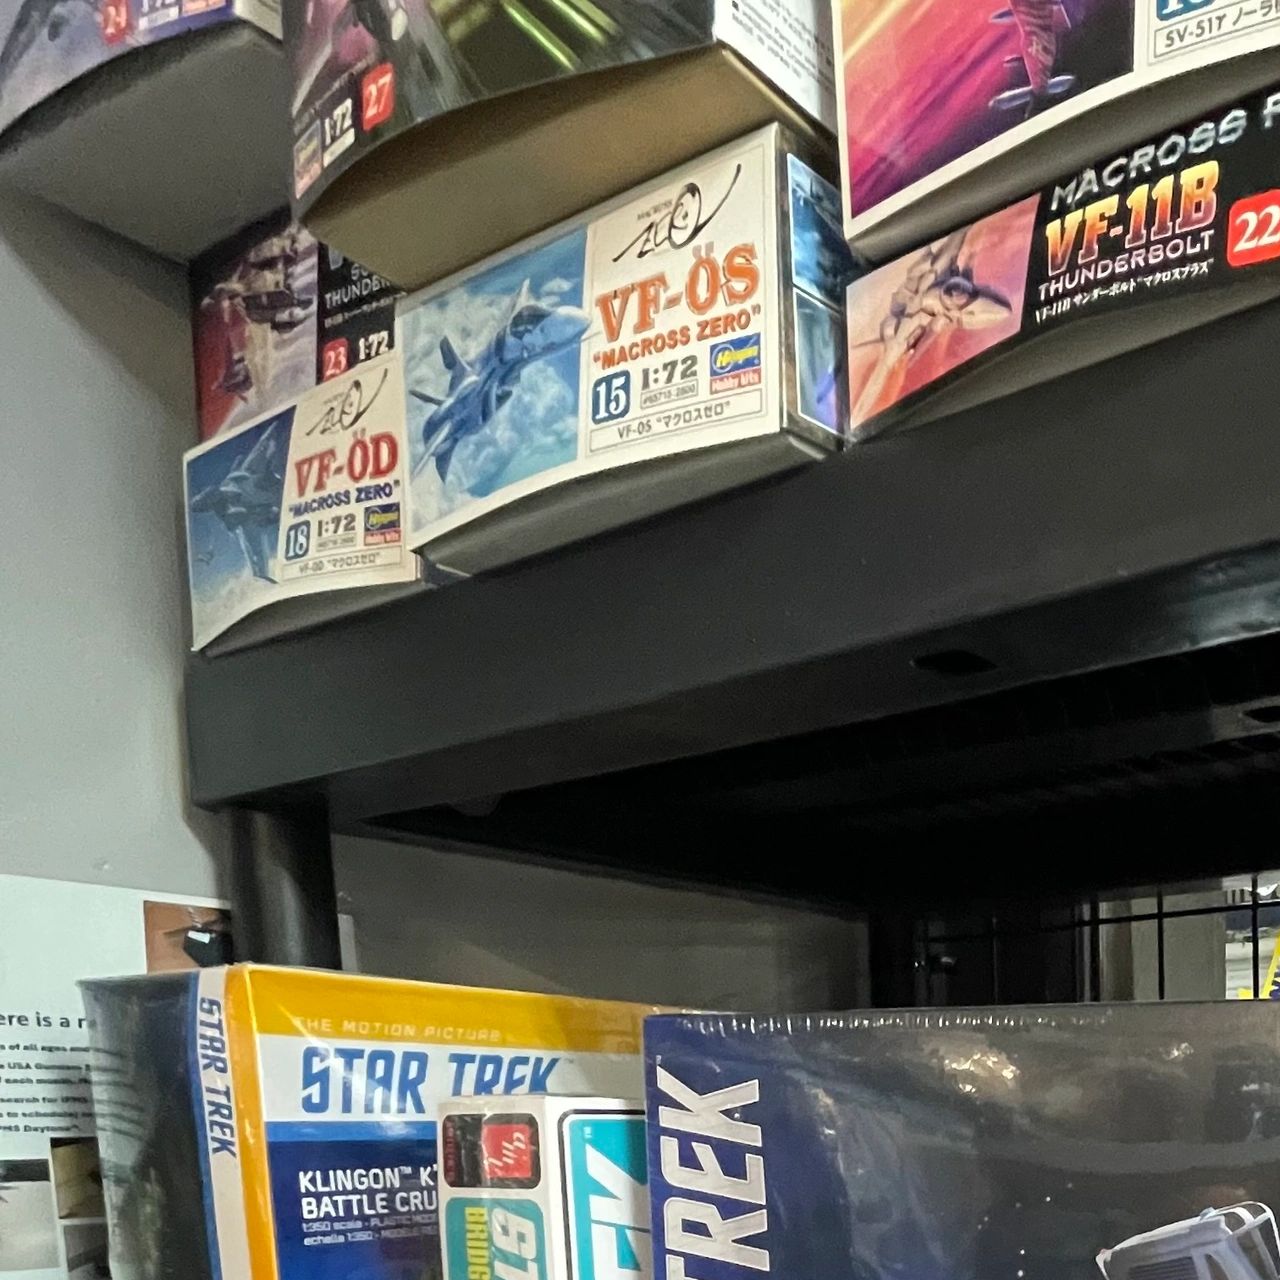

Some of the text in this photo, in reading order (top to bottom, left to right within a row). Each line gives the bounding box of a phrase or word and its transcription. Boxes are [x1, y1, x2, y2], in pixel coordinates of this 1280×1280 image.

[364, 71, 393, 119] 27
[323, 98, 353, 147] 1:72
[1050, 109, 1249, 213] MACROSS
[1045, 159, 1220, 278] VF-11B
[1038, 229, 1216, 302] THUNDERBOLT
[325, 346, 347, 378] 23
[358, 330, 389, 361] 1:72
[641, 354, 699, 391] 1:72
[596, 375, 627, 421] 15
[287, 523, 308, 558] 18
[317, 513, 357, 538] 1:72
[35, 1011, 71, 1029] is a
[342, 1020, 417, 1037] MOTION
[424, 1026, 501, 1042] PICTURE
[198, 996, 238, 1160] STAR TREK
[300, 1045, 430, 1115] STAR
[301, 1193, 391, 1220] BATTLE
[332, 1219, 363, 1231] scale
